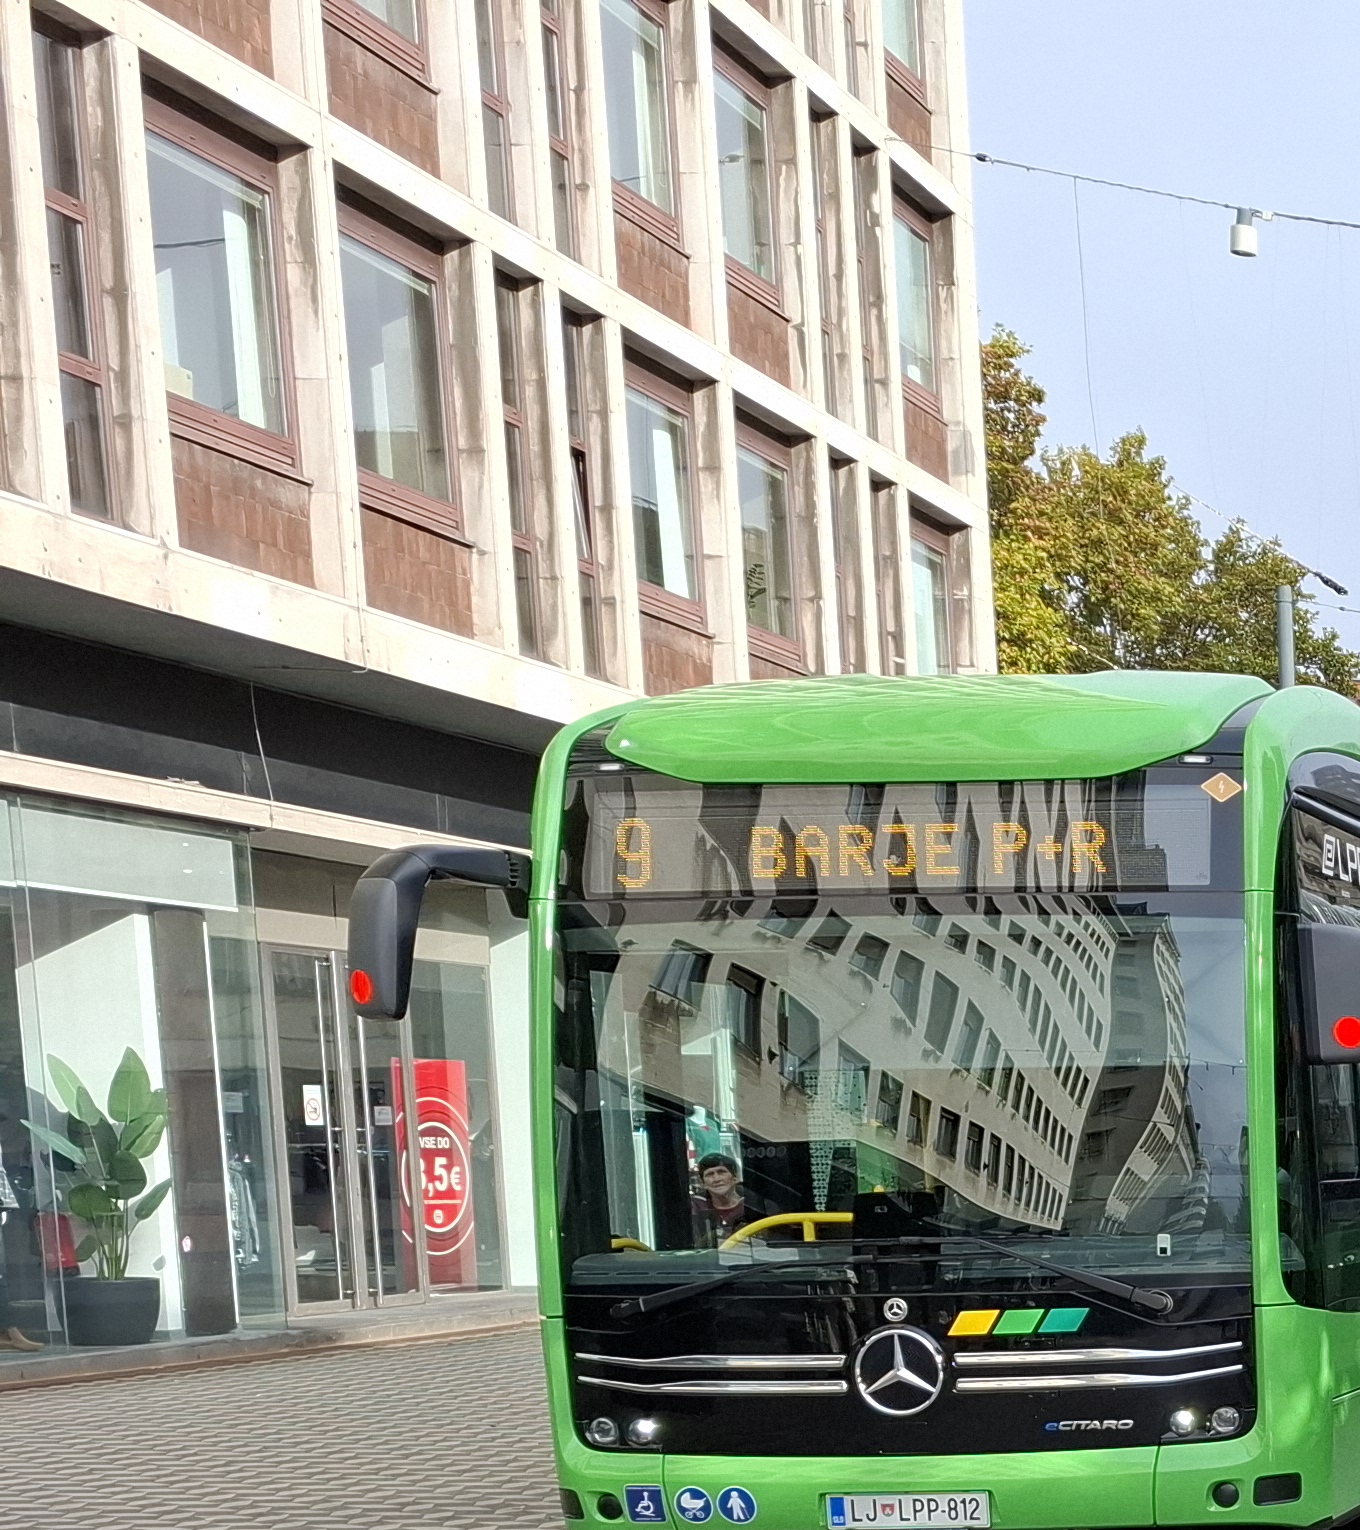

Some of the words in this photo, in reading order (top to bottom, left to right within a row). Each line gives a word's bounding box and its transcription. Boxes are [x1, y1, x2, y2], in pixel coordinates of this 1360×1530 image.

[615, 817, 652, 888] 9
[750, 822, 960, 878] BARJE
[992, 820, 1107, 875] P+R
[419, 1137, 437, 1148] VSE
[437, 1137, 450, 1149] DO
[1045, 1419, 1134, 1431] eCITARO
[851, 1498, 878, 1522] LJ
[898, 1497, 981, 1522] LPP-812
